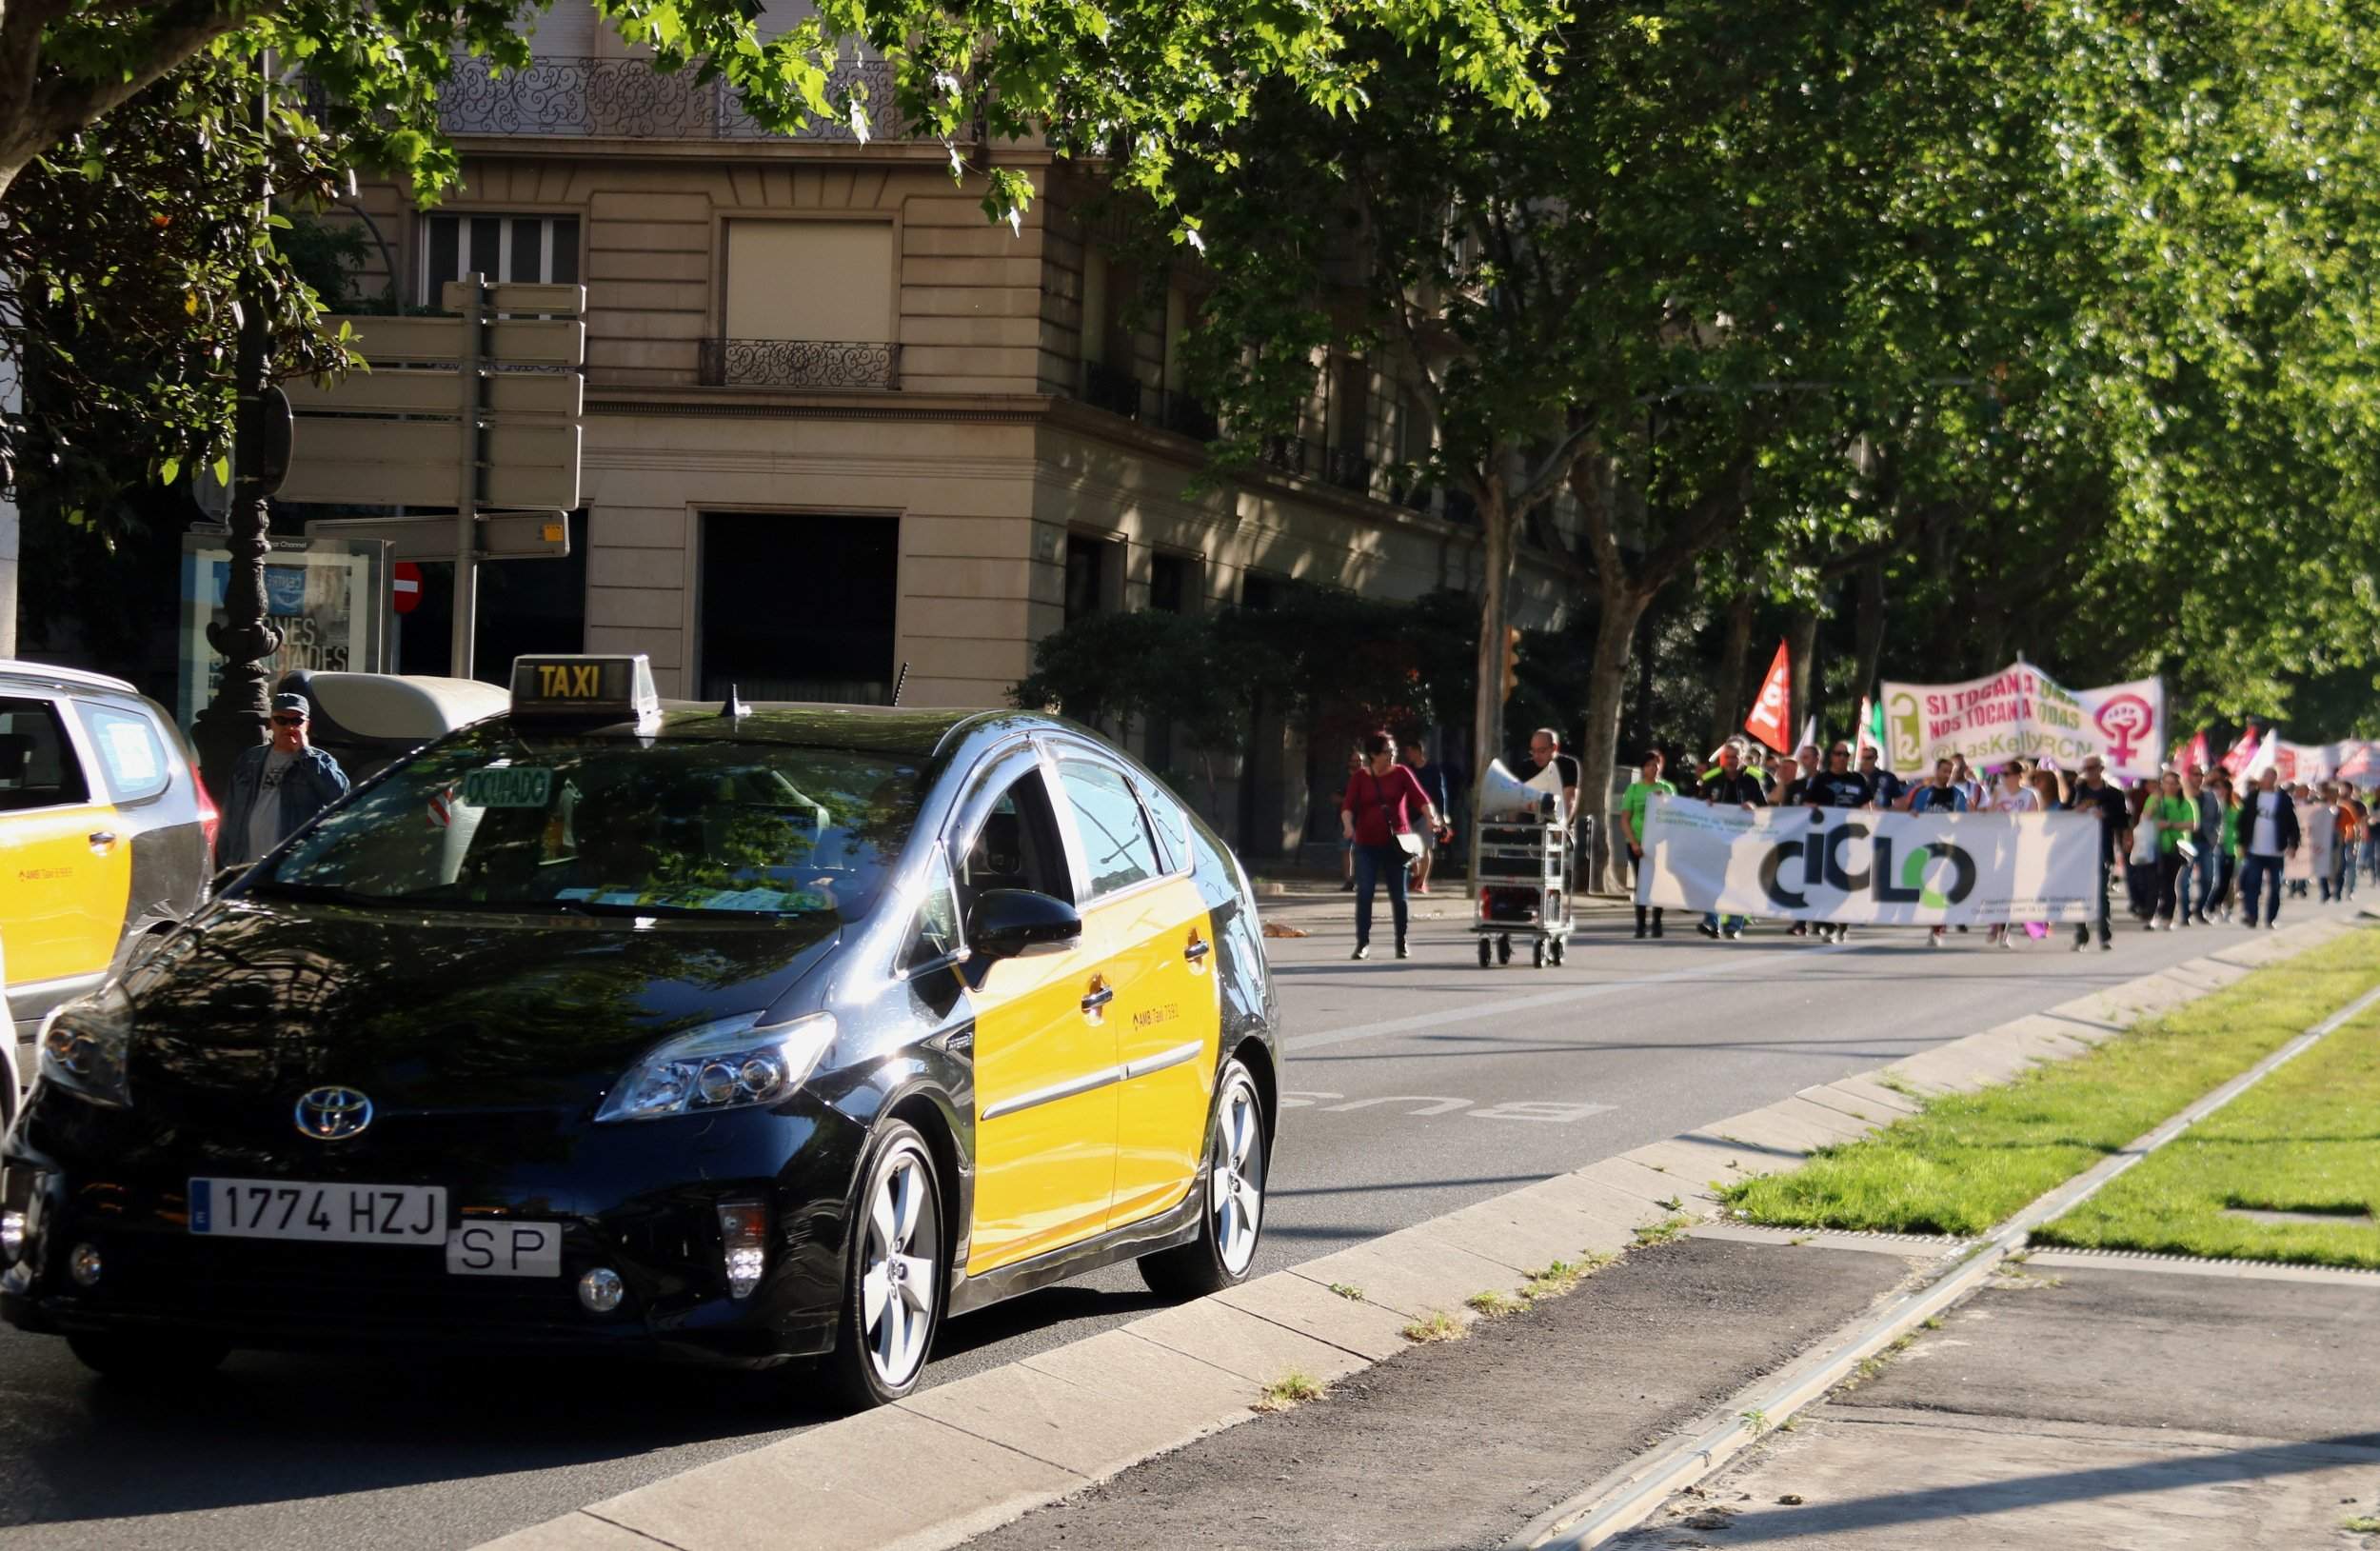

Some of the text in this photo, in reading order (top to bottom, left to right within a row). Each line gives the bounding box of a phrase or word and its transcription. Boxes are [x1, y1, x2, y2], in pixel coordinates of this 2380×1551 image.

[539, 666, 600, 698] TAXI
[1926, 695, 1948, 716] SI
[1952, 673, 2019, 710] TOCAN
[1929, 719, 1962, 740] NOS
[1967, 699, 2019, 727] TOCAN
[2022, 698, 2033, 719] A
[467, 769, 546, 804] OCUPADO
[226, 1186, 331, 1231] 1774
[349, 1191, 435, 1235] HZJ
